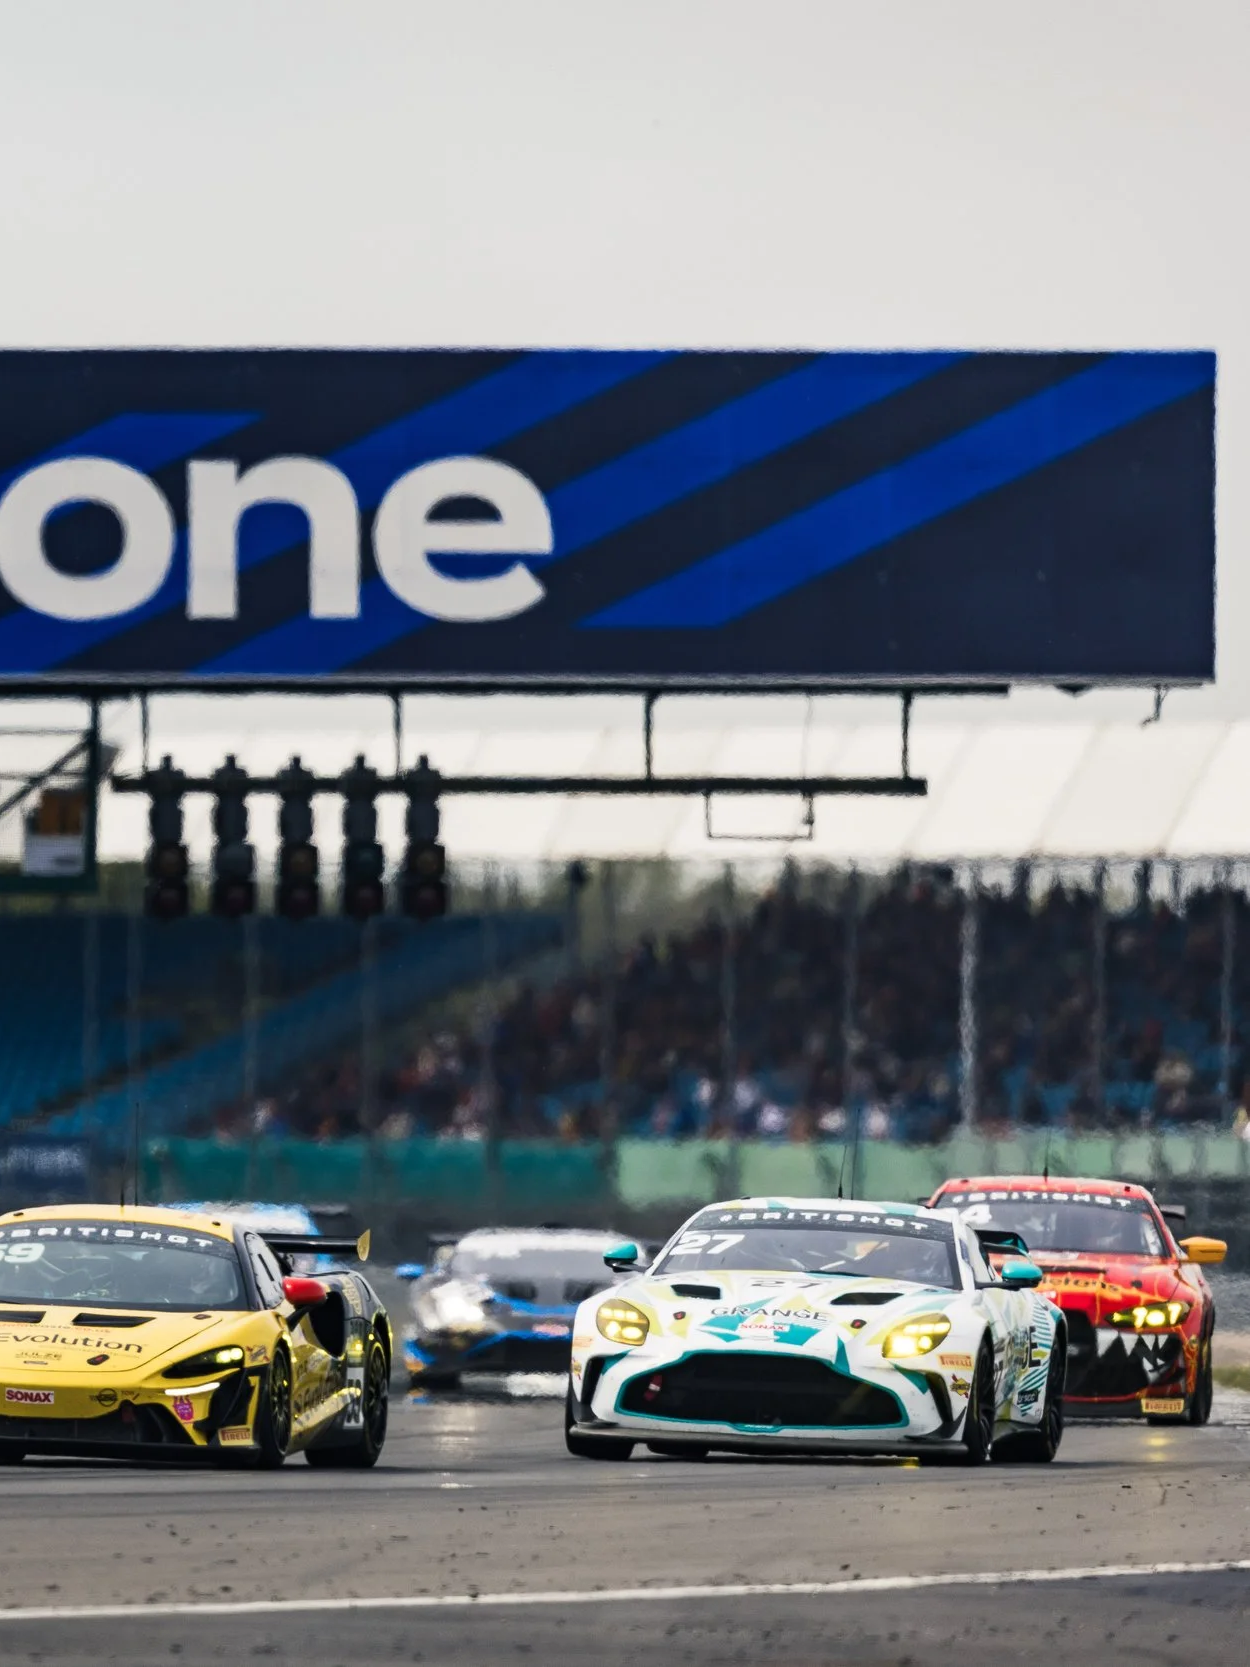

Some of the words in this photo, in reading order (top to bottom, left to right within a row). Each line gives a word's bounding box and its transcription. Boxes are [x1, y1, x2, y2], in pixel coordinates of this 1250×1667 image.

[720, 1211, 929, 1231] #BRITISHGT
[669, 1233, 745, 1255] 27
[751, 1280, 822, 1289] 27
[710, 1305, 830, 1322] GRANGE
[740, 1323, 785, 1331] SONAX
[940, 1354, 972, 1368] PIRELLI
[5, 1389, 51, 1403] SONAX
[221, 1427, 251, 1441] PIRELLI
